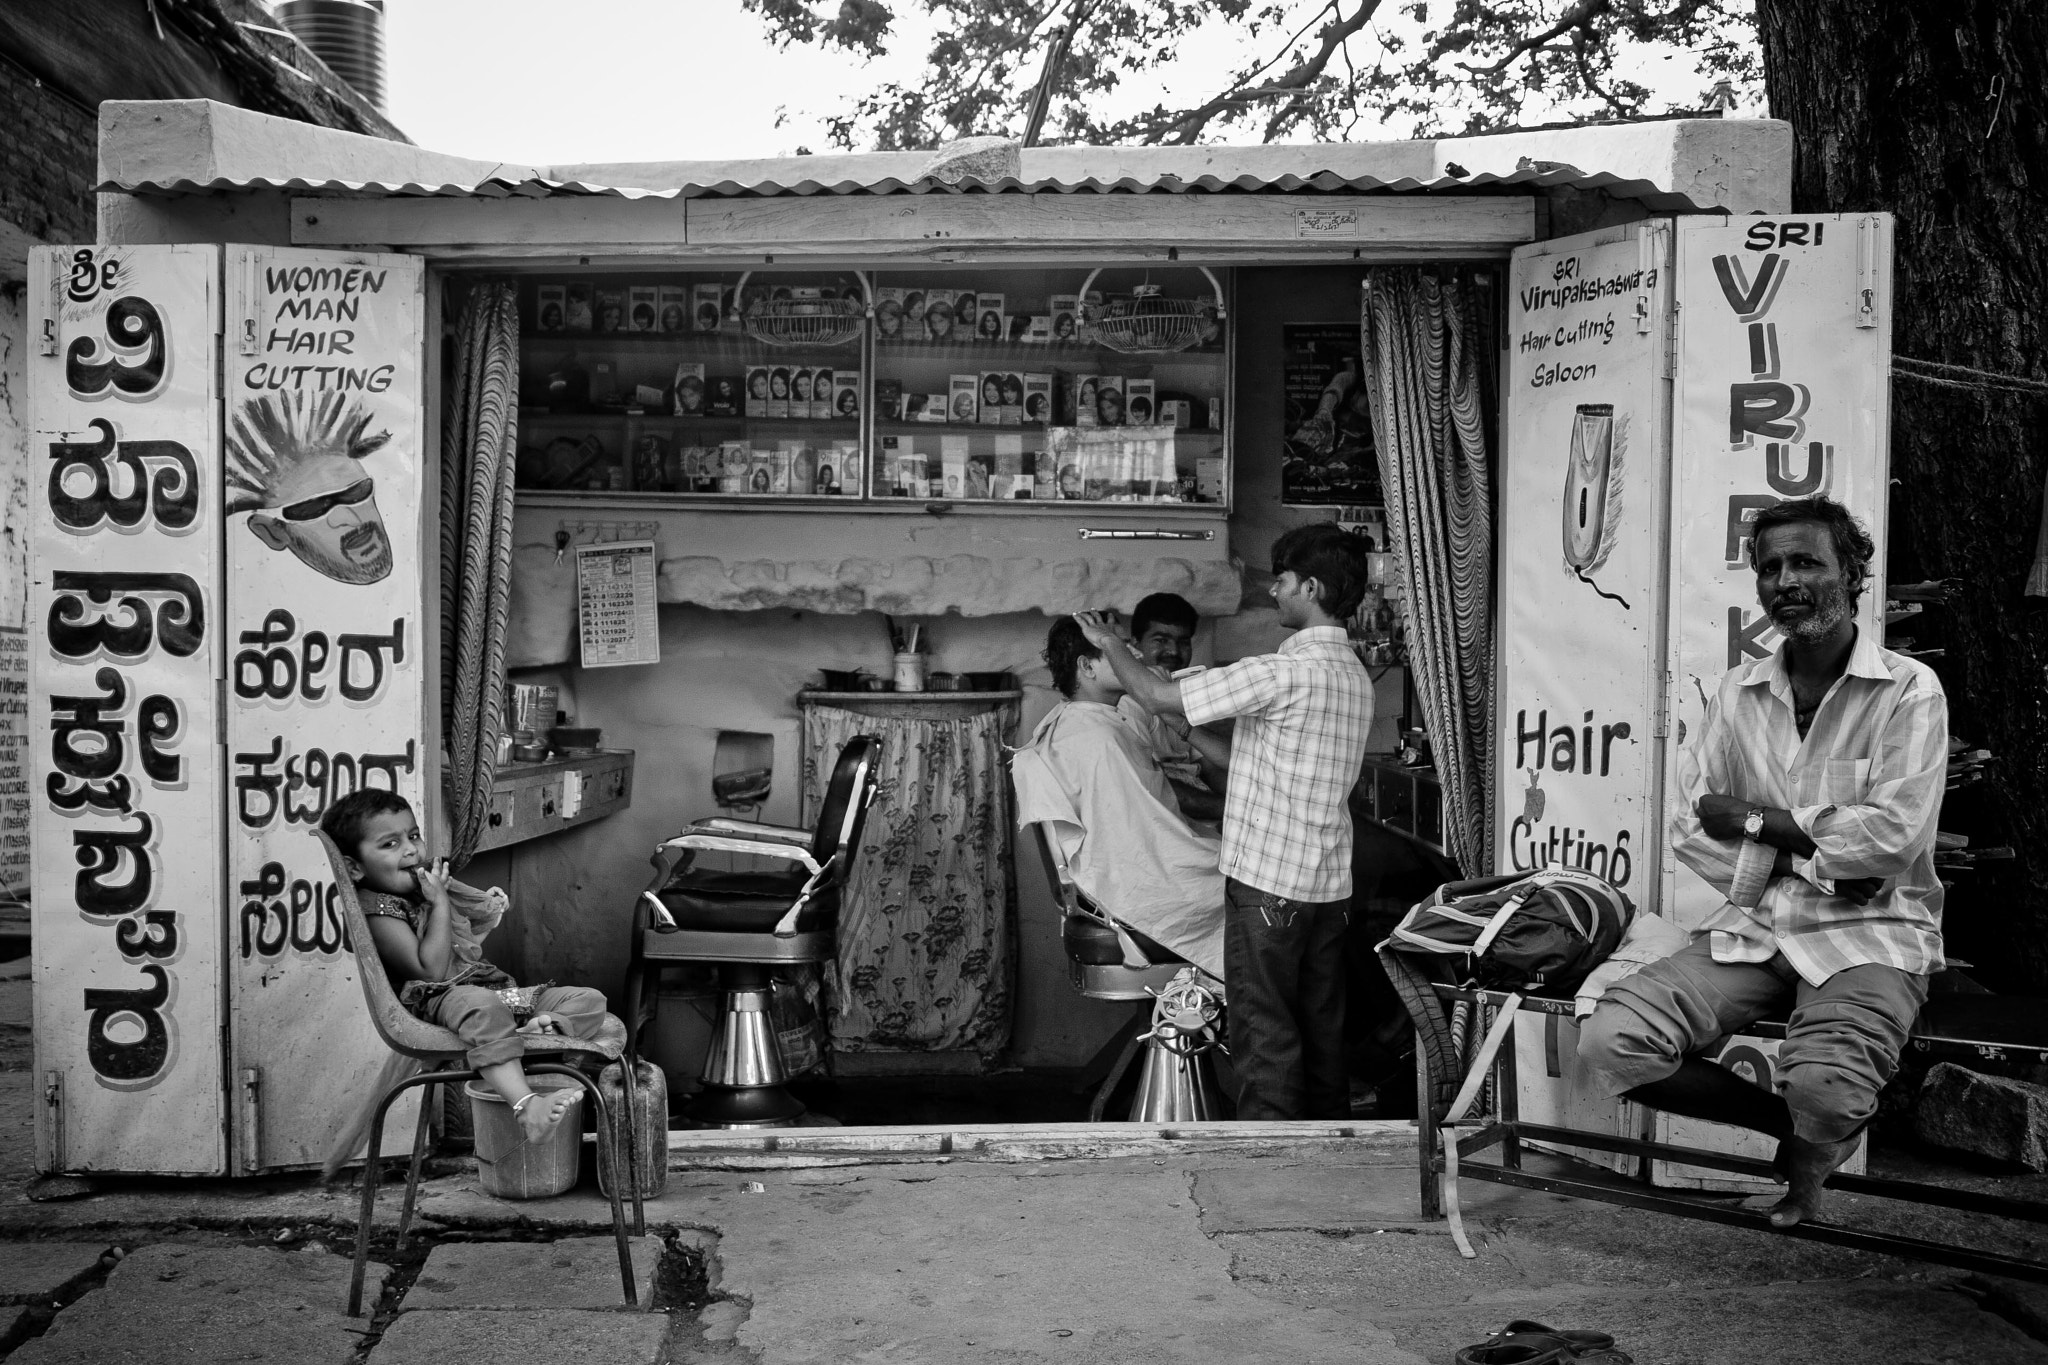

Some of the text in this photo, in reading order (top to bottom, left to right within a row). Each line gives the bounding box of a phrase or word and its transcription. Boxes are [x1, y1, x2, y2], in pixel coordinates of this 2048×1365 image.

[1744, 221, 1824, 251] SRI
[67, 248, 120, 303] ಶ್ರೀ
[265, 266, 388, 297] WOMEN
[1553, 257, 1581, 282] SRI
[275, 297, 360, 324] MAN
[266, 328, 356, 357] HAIR
[1520, 312, 1616, 354] Hair Cutting
[244, 363, 395, 394] CUTTING
[1531, 362, 1597, 389] Saloon
[233, 608, 405, 703] ಹೇರ್
[1516, 709, 1631, 777] Hair
[1510, 815, 1632, 888] Cutting
